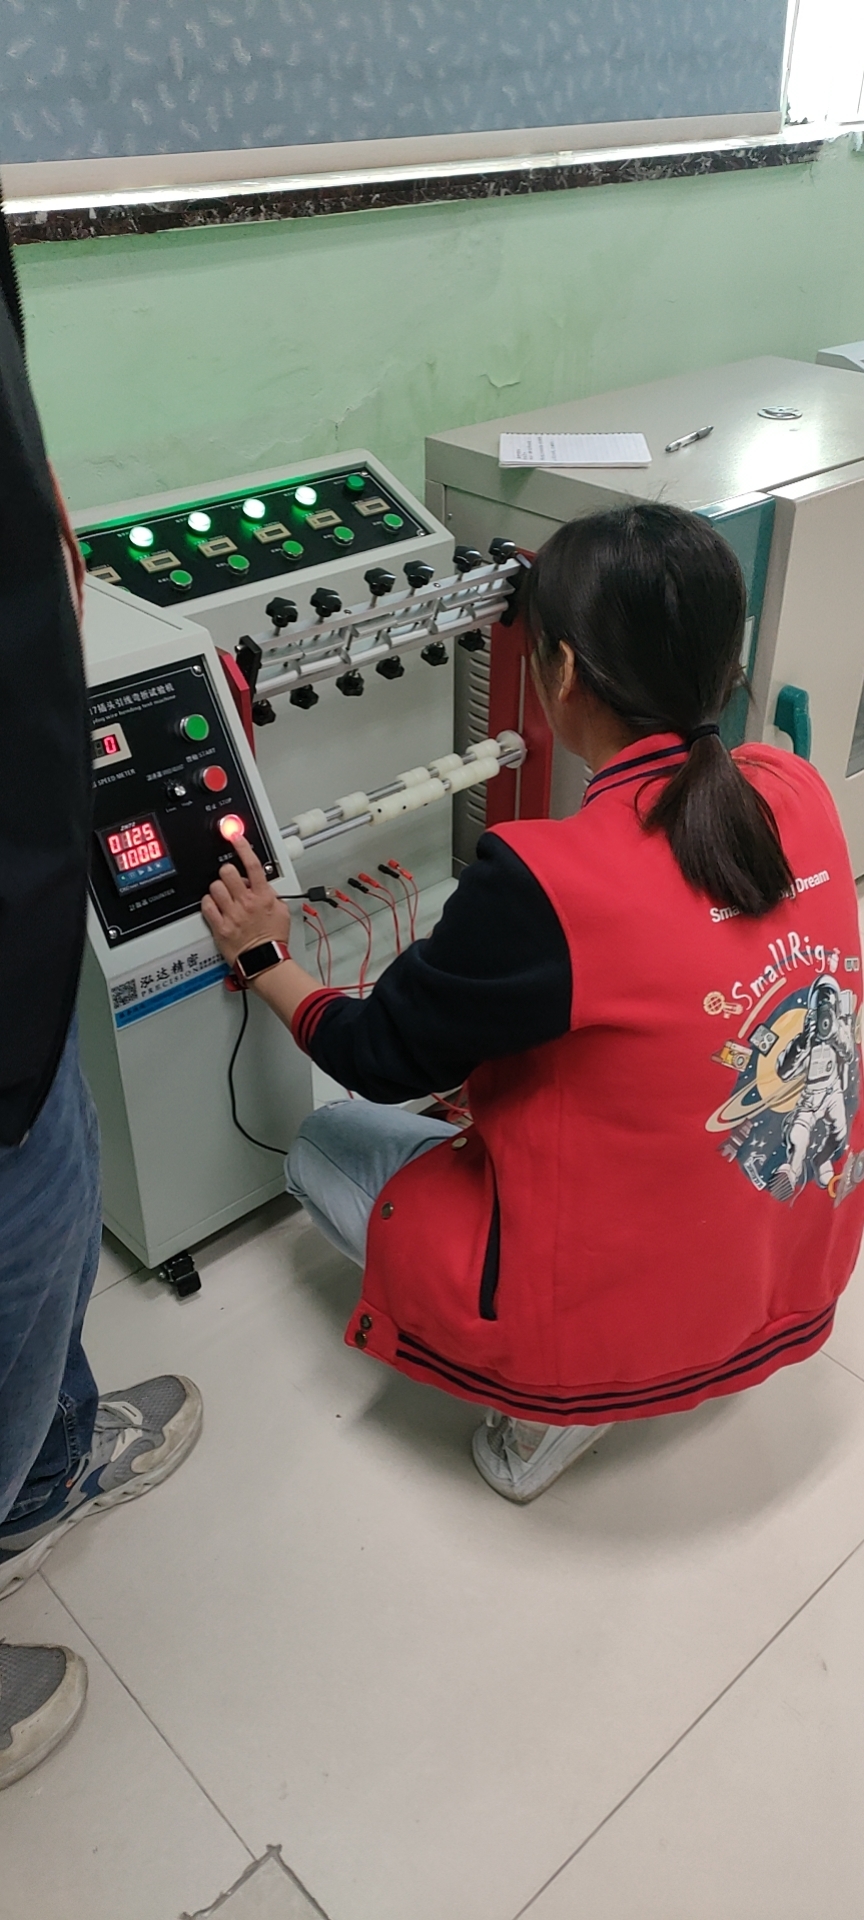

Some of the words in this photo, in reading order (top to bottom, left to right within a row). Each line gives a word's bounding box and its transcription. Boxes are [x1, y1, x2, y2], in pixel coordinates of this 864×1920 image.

[104, 736, 117, 755] 0
[108, 823, 155, 854] 0125
[121, 840, 162, 870] 1000
[794, 869, 830, 893] Dream
[141, 967, 199, 997] PRECISION
[731, 931, 826, 1011] SmallRig
